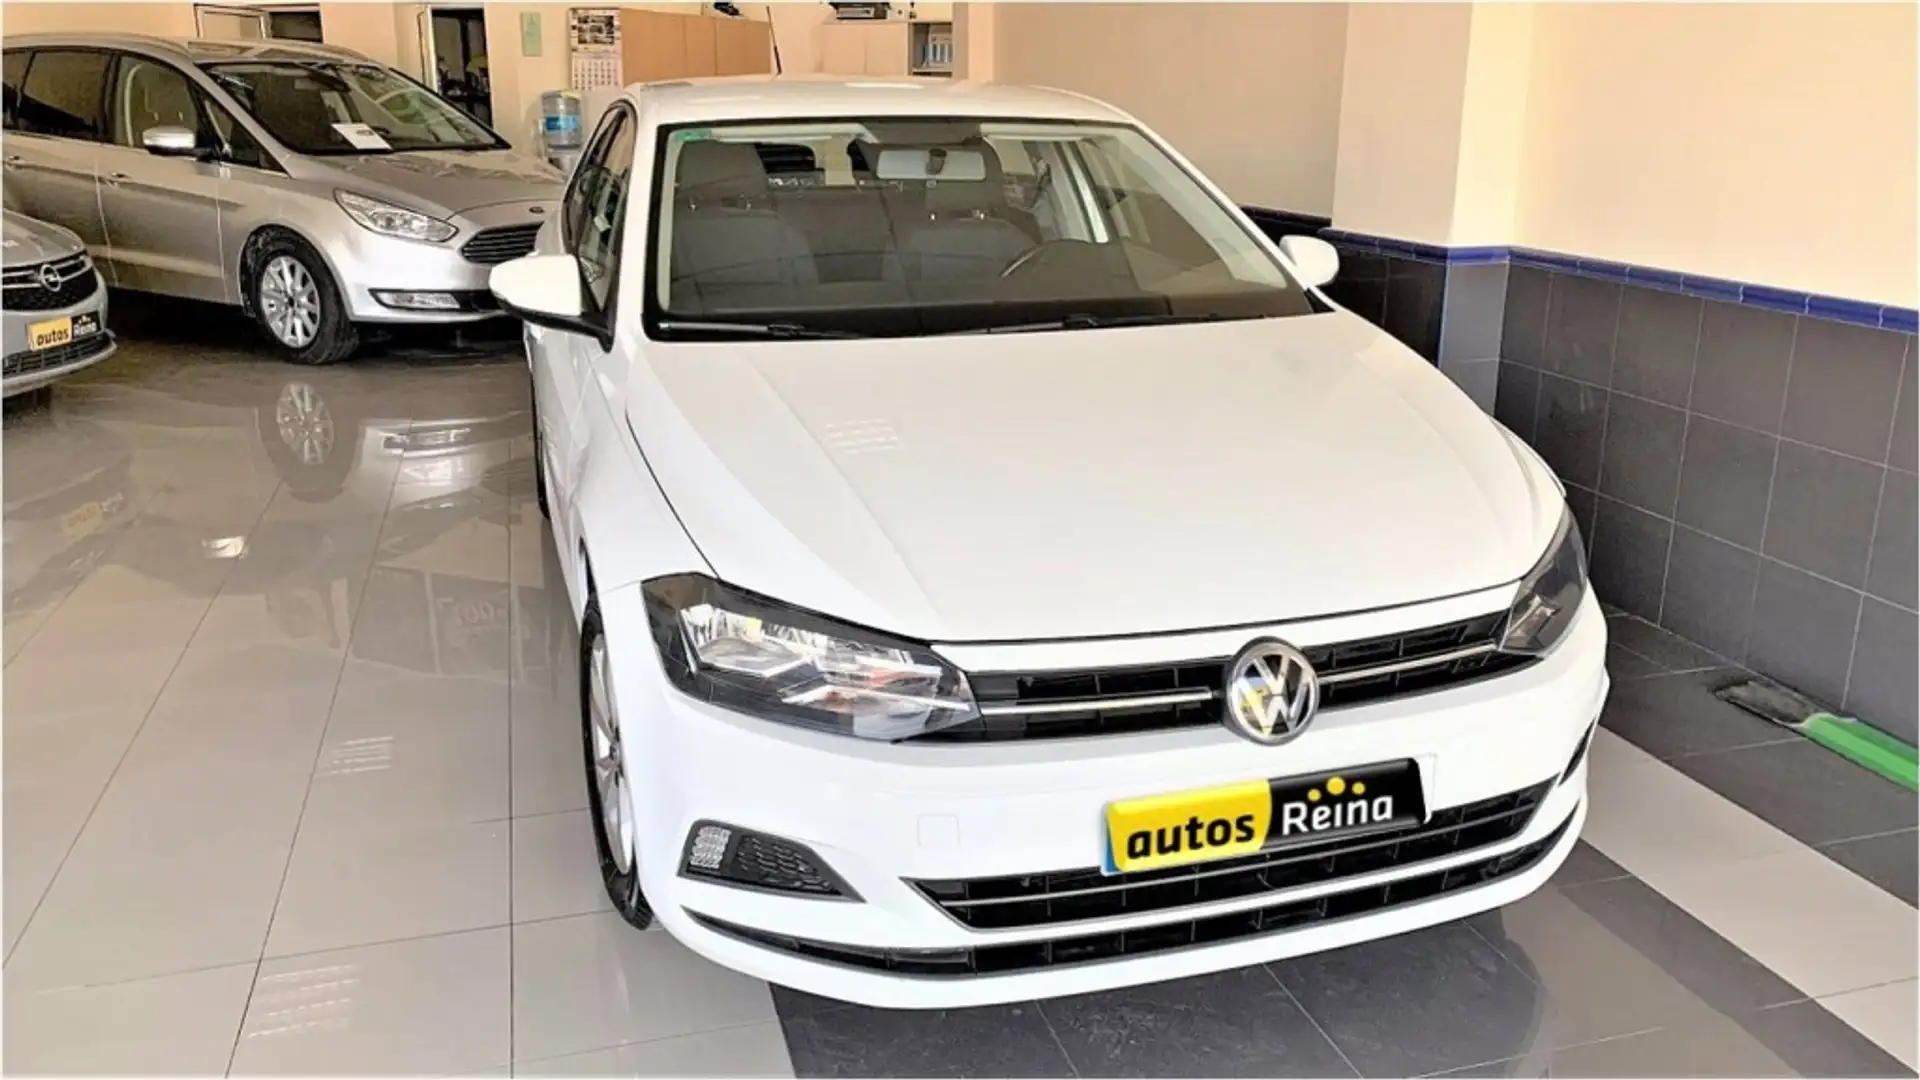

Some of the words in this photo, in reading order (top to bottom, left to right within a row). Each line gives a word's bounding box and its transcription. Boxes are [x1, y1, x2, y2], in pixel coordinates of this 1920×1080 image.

[37, 328, 69, 345] autos
[1127, 813, 1256, 860] autos
[1282, 795, 1393, 836] Reina
